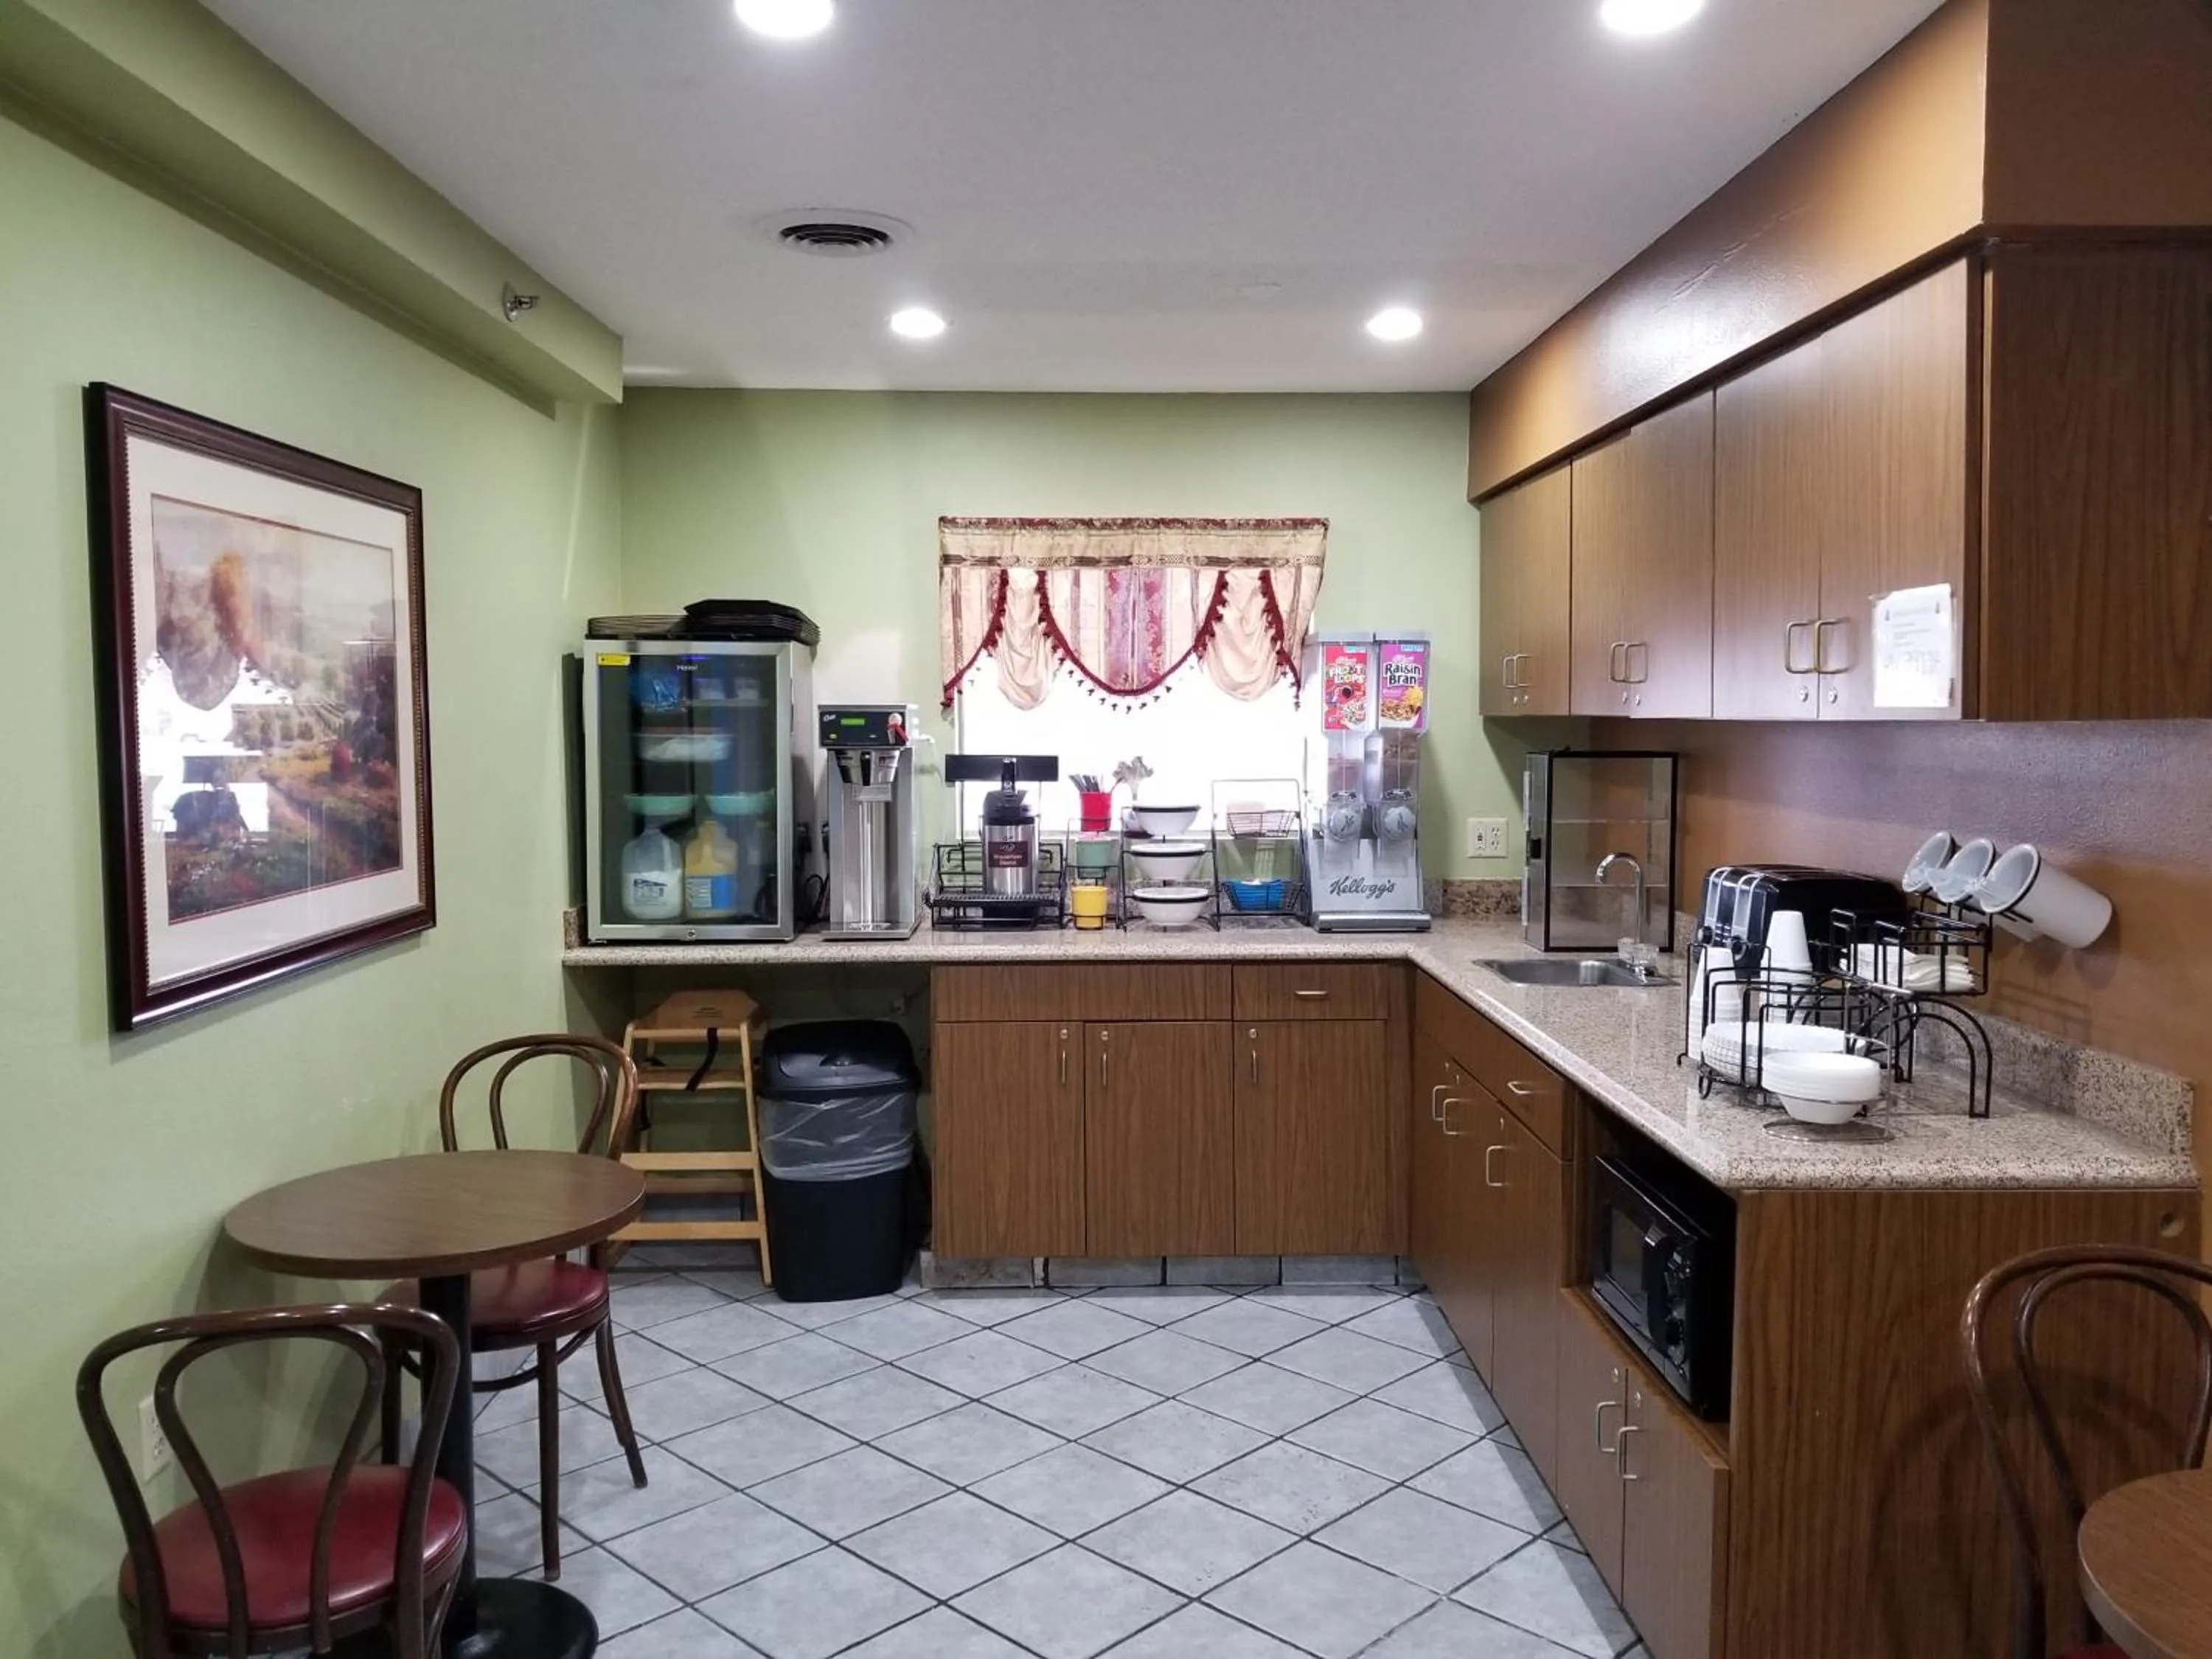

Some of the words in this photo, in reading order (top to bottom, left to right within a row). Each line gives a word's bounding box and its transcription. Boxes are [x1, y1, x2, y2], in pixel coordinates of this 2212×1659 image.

[1385, 663, 1420, 675] Raisin
[1389, 674, 1417, 685] Bran
[1329, 875, 1396, 899] Kellogg's
